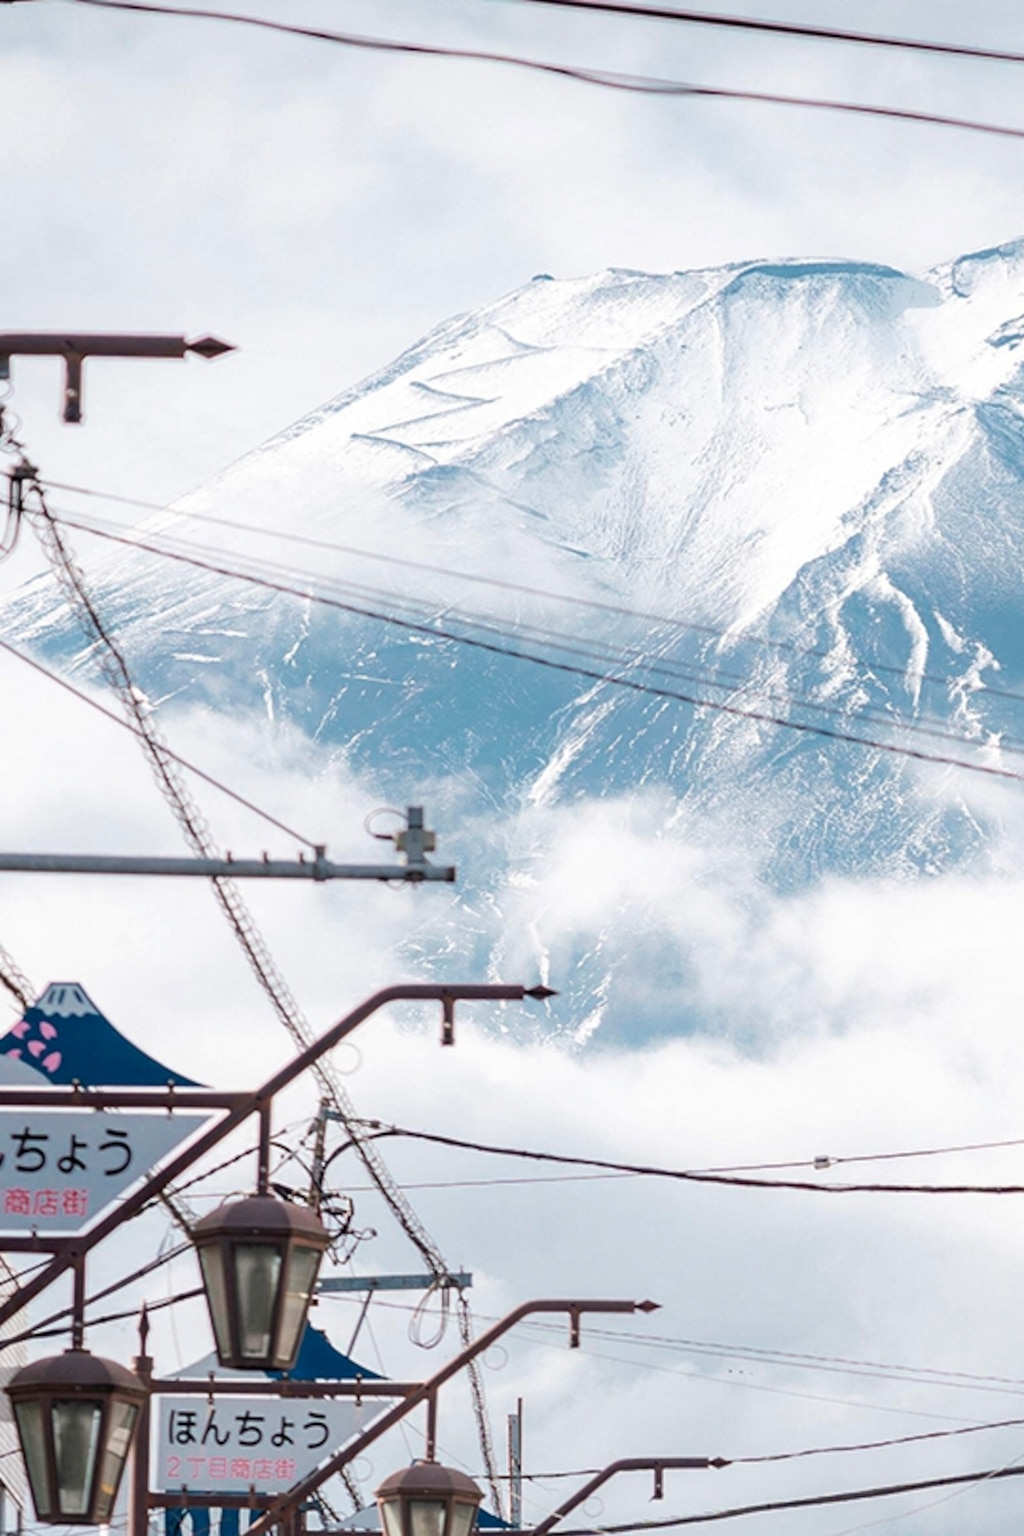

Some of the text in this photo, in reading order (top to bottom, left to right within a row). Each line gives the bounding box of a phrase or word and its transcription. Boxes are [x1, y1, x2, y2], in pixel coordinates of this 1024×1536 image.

[0, 1127, 132, 1175] ちょう
[168, 1410, 330, 1449] ほんちょう
[166, 1456, 296, 1480] 2丁目商店街
